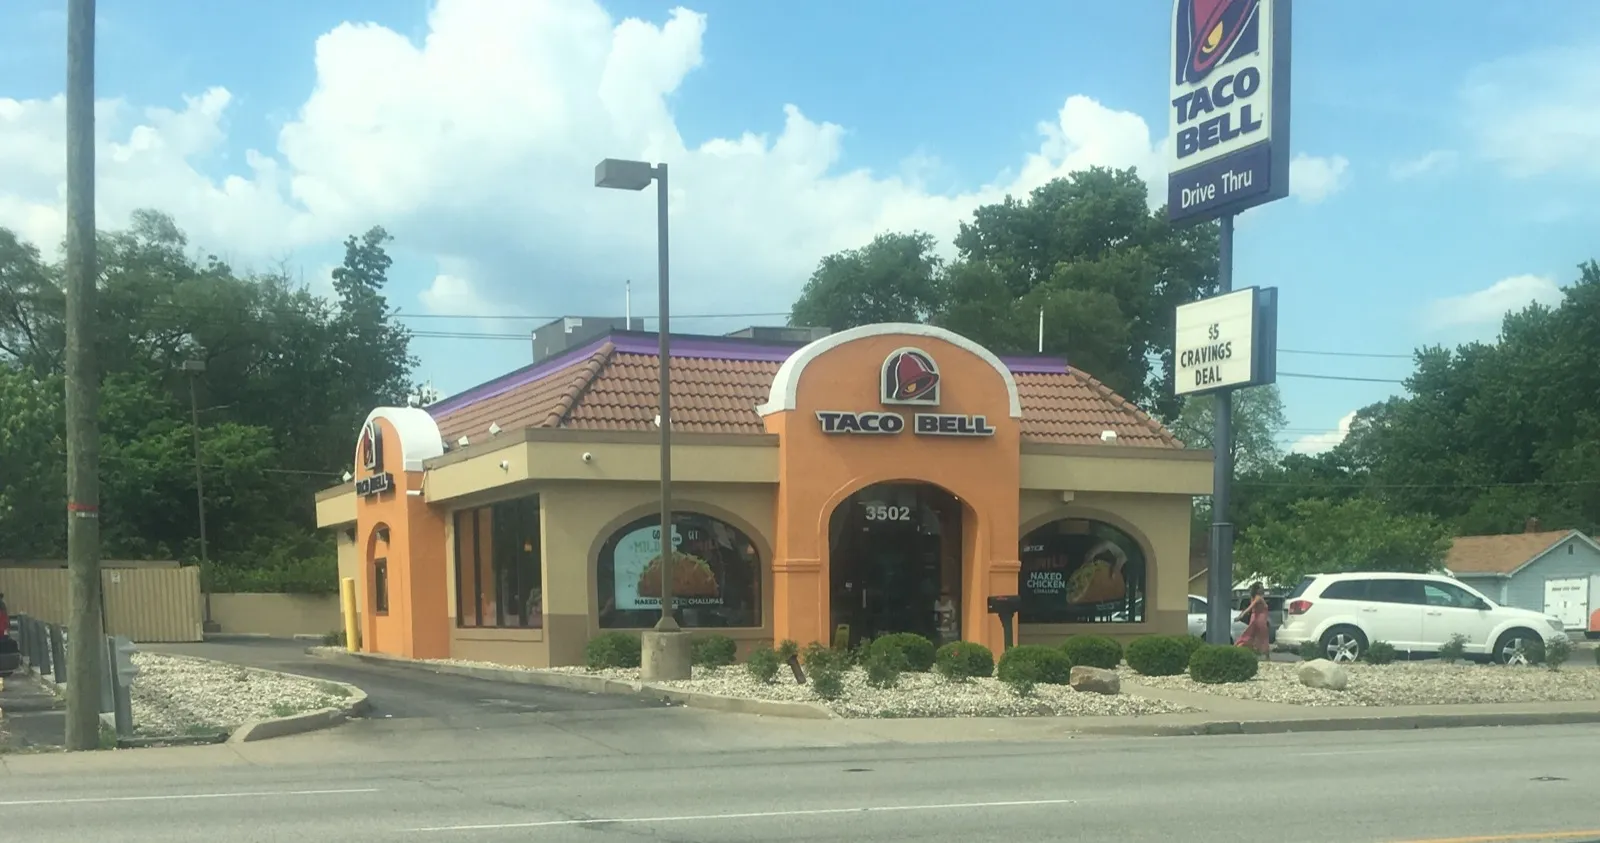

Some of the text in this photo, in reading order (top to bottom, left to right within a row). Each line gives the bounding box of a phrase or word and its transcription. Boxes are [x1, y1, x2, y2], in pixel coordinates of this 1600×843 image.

[1172, 66, 1260, 125] TACO
[1176, 103, 1263, 160] BELL
[1181, 169, 1252, 209] Drive Thru
[1208, 323, 1220, 341] $5
[1180, 341, 1232, 368] CRAVINGS
[1195, 365, 1222, 386] DEAL
[816, 411, 996, 435] TACO BELL
[865, 506, 911, 521] 3502
[1026, 580, 1066, 588] CHICKEN
[1030, 572, 1062, 580] NAKED
[689, 597, 724, 605] CHALUPAS
